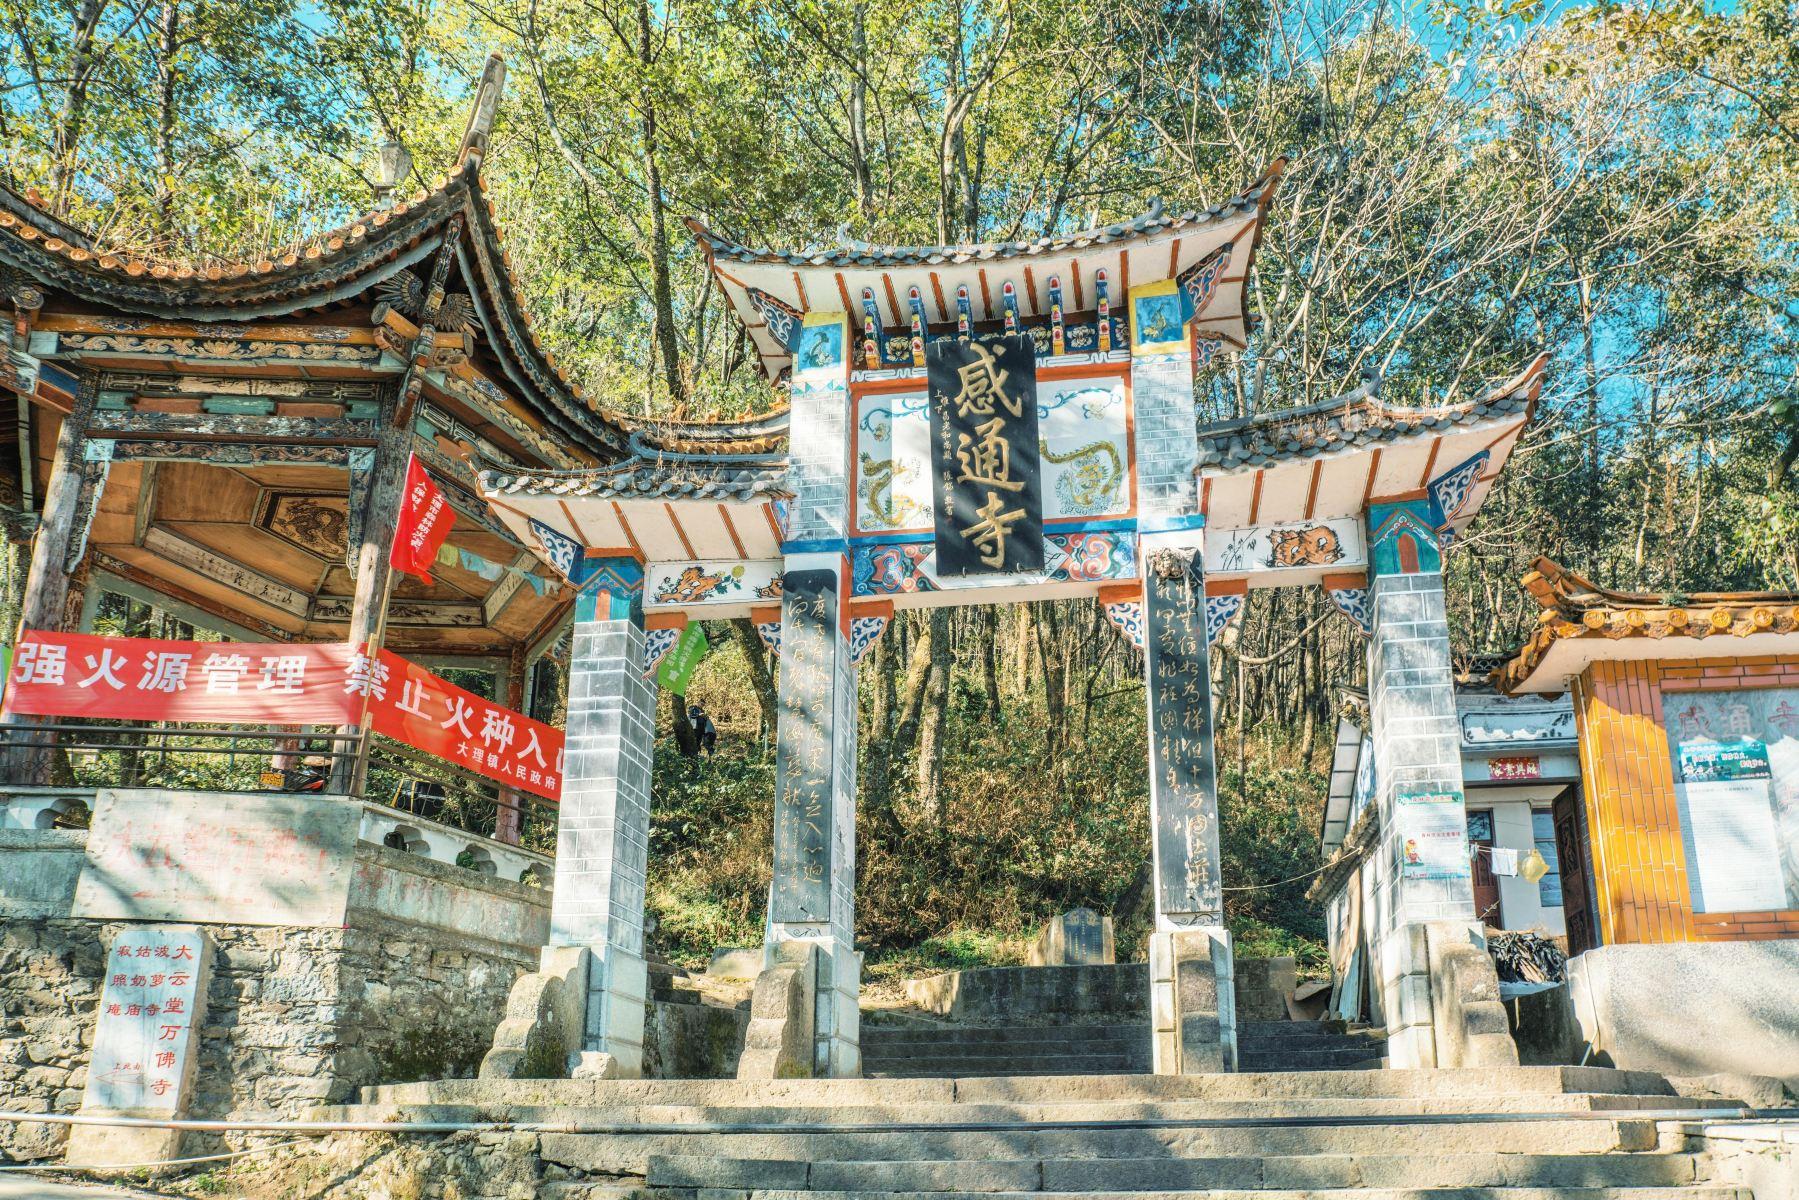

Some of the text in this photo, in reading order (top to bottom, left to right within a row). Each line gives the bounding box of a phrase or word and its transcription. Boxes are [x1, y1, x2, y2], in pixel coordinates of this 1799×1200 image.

[953, 342, 1028, 569] 感通寺
[456, 741, 556, 790] 大理镇人民政府
[106, 945, 132, 1016] 寂照庵
[125, 945, 152, 1016] 姑奶庙
[151, 944, 193, 1096] 大云堂万佛寺
